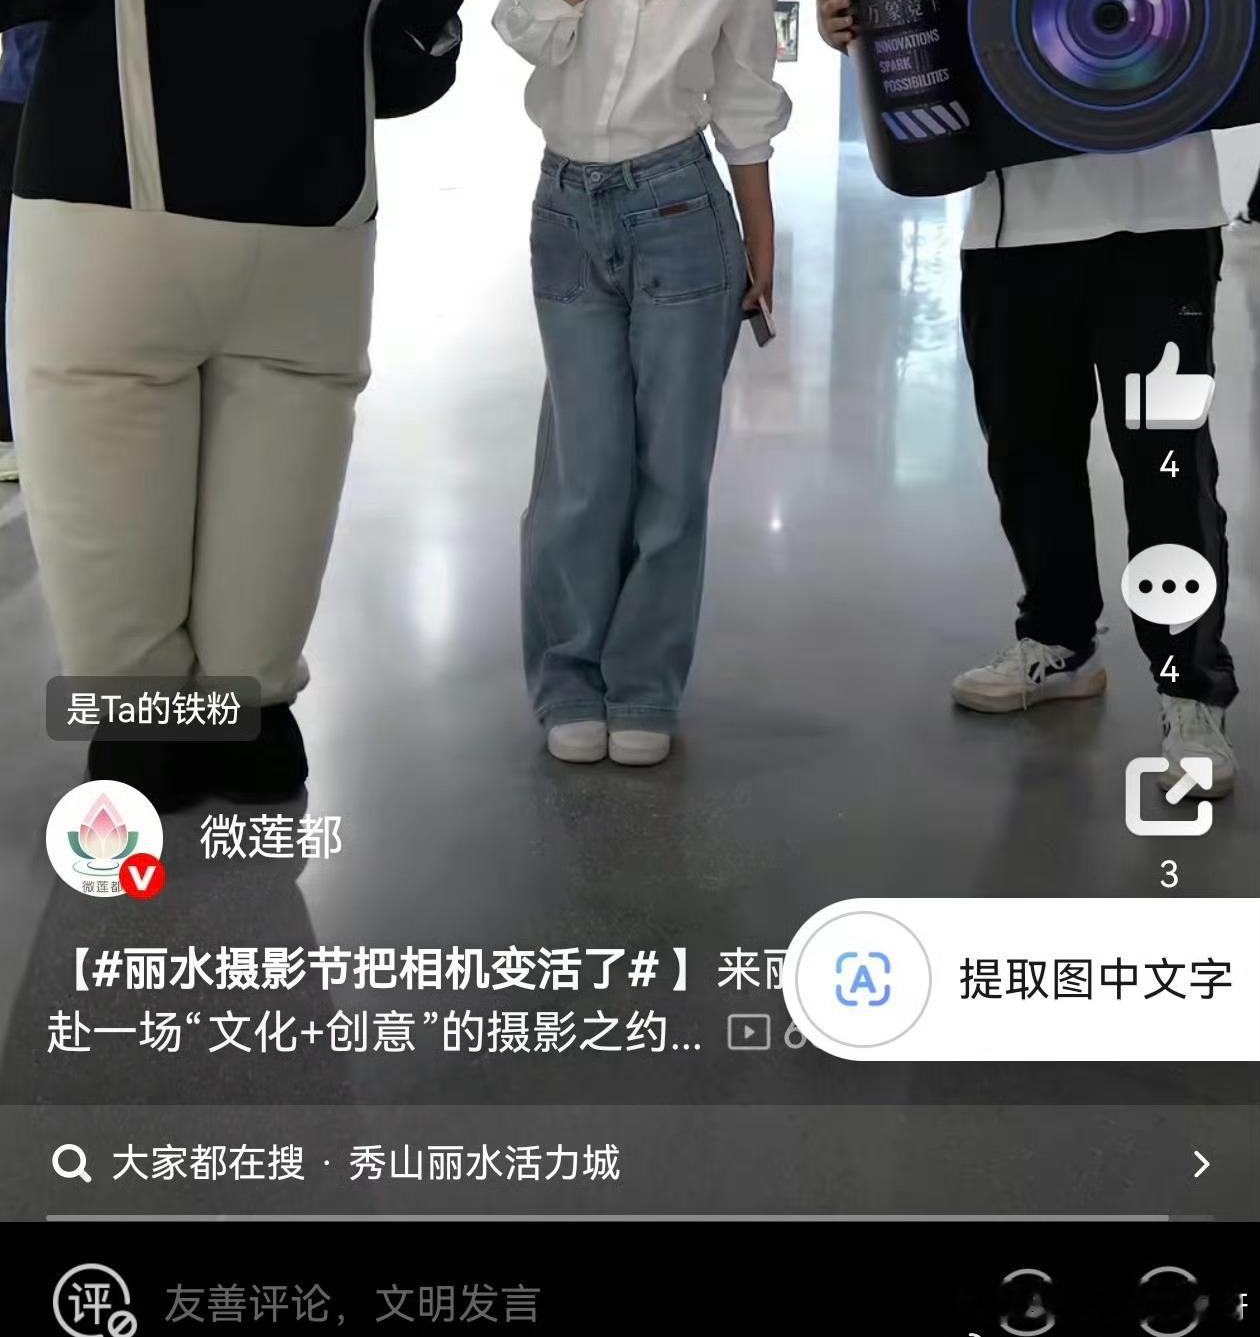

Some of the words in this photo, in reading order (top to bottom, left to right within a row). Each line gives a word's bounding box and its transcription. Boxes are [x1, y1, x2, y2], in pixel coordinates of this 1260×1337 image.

[874, 29, 940, 55] INNOVATIONS
[879, 56, 912, 73] SPARK
[884, 68, 950, 94] POSSIBILITIES
